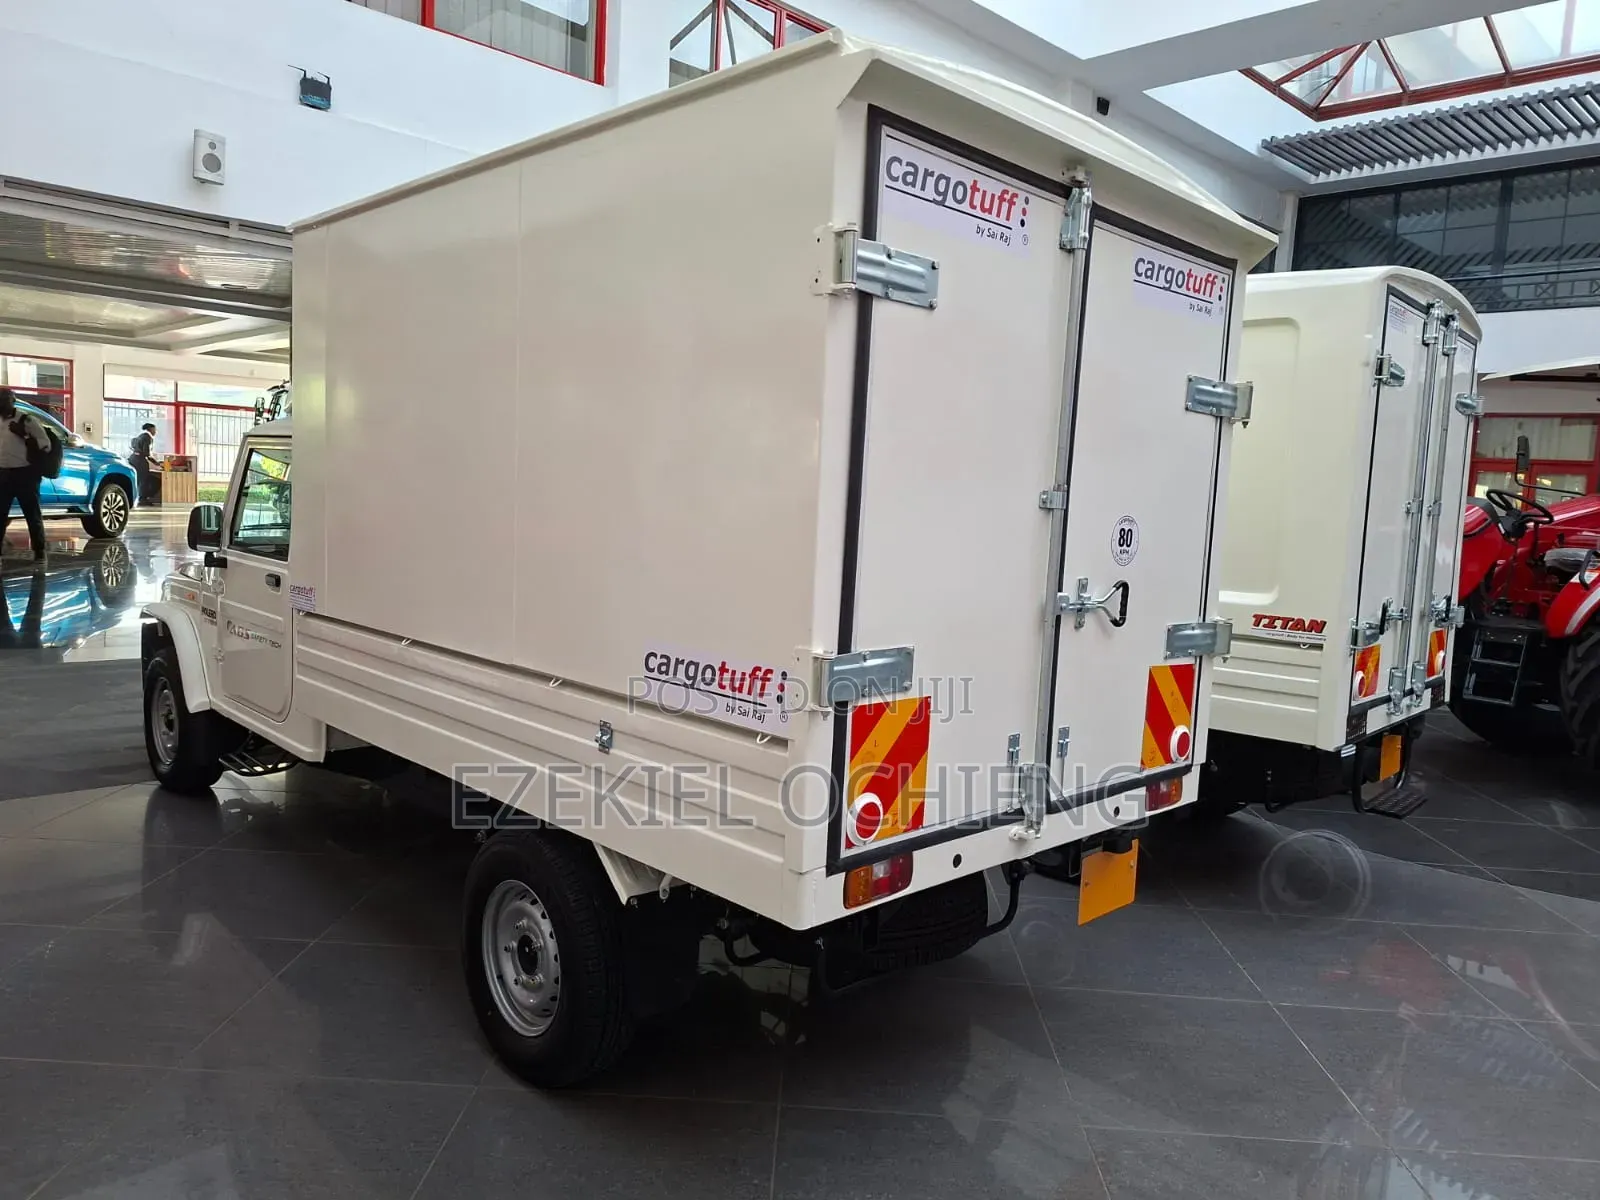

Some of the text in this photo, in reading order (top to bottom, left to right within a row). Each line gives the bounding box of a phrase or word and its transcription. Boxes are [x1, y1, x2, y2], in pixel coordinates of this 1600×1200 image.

[885, 155, 1019, 222] cargotuff
[976, 224, 1012, 247] by Sai Raj
[1134, 257, 1218, 298] cargotuff
[1188, 302, 1196, 312] by
[1118, 527, 1133, 548] 80
[1252, 613, 1327, 634] TITAN
[644, 651, 774, 699] cargotuff
[725, 702, 766, 724] by Sai Raj
